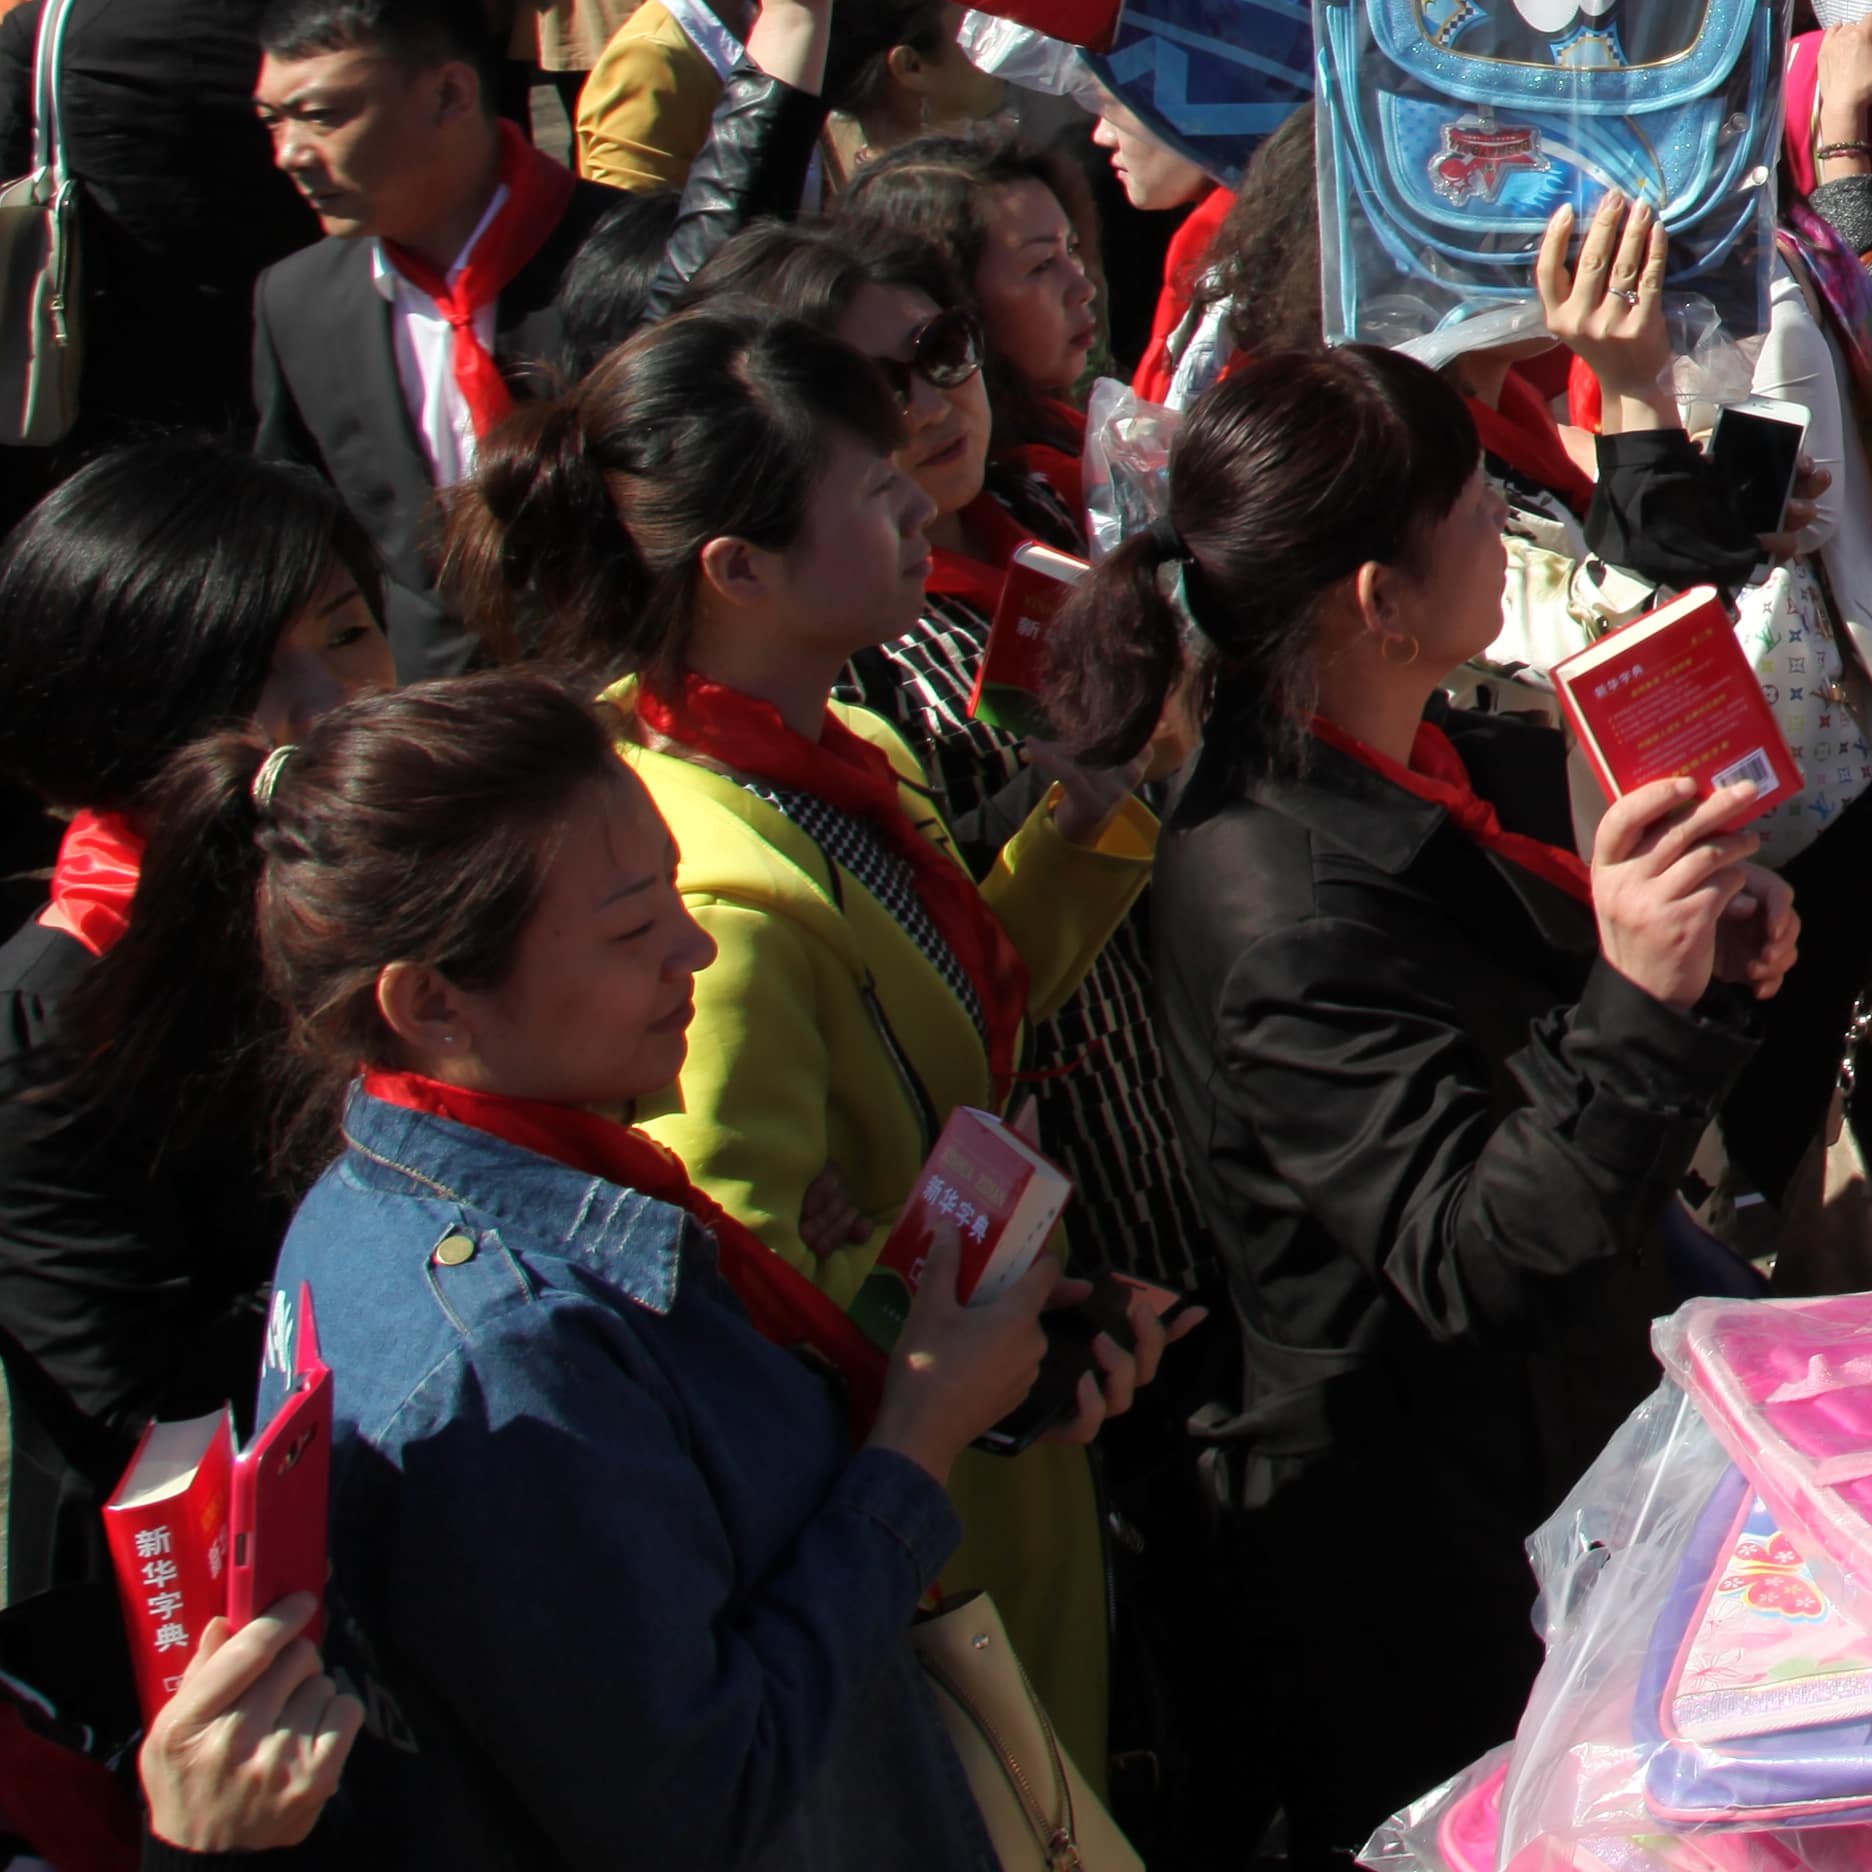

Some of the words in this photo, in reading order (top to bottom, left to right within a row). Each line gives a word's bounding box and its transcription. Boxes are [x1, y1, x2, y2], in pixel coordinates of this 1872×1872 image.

[922, 1174, 990, 1245] 新华字典
[133, 1524, 190, 1654] 新华字典
